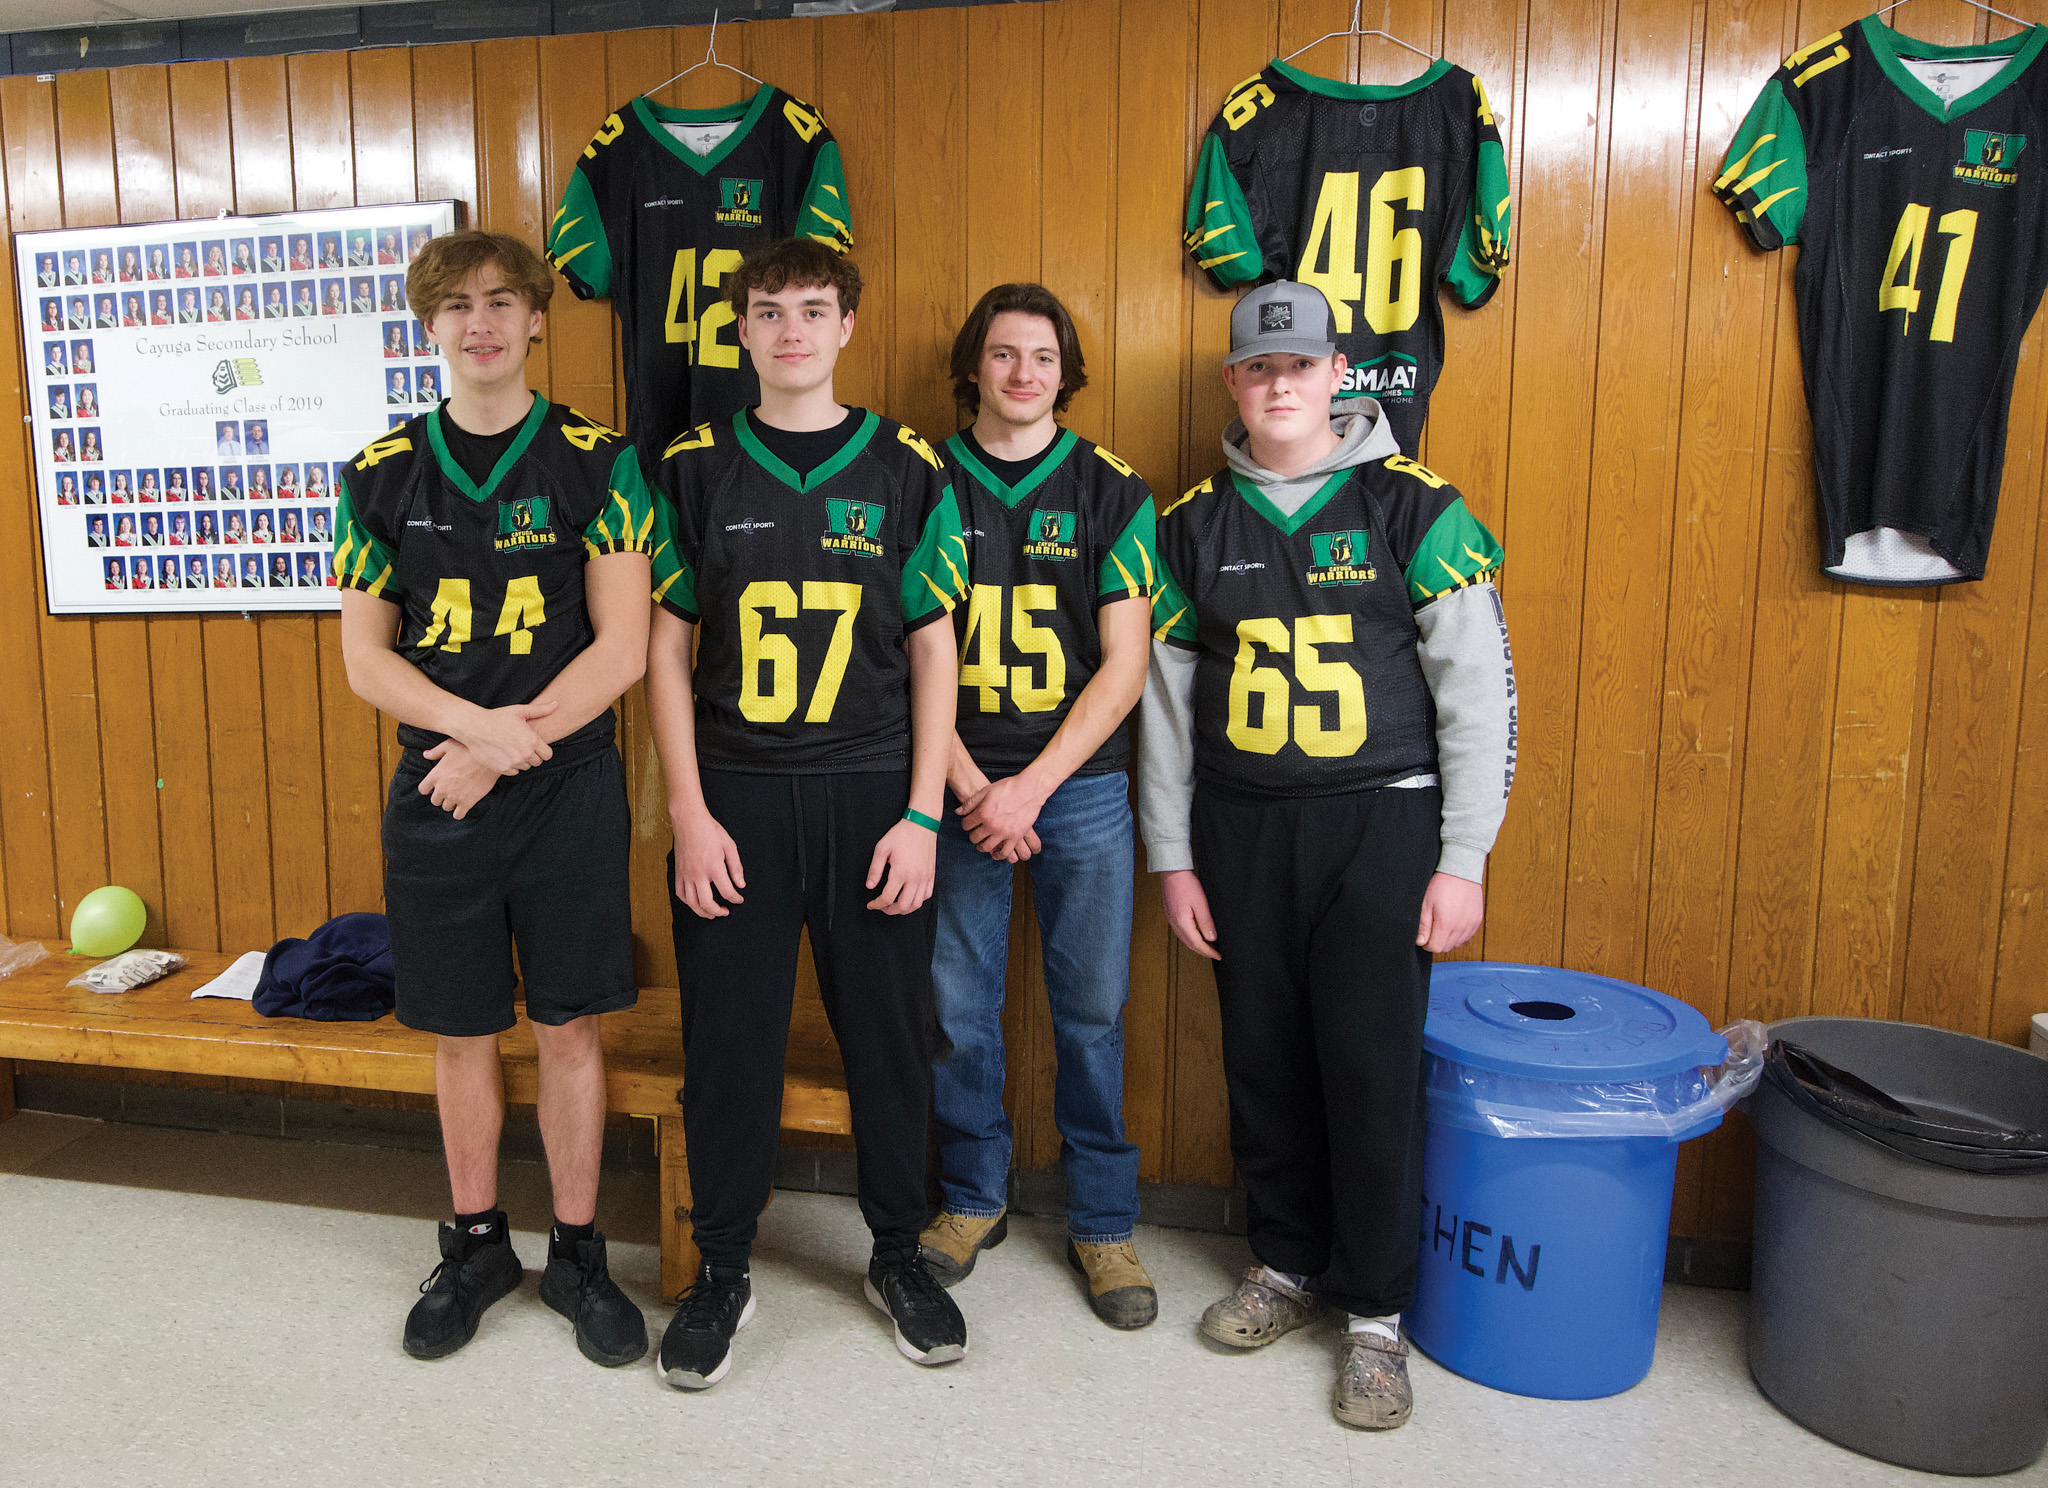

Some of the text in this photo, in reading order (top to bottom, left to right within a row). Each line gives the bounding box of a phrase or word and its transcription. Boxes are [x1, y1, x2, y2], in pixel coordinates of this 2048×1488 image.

[783, 97, 828, 143] 4
[1954, 166, 2018, 184] WARRIORS
[716, 212, 762, 224] WARRIORS
[1297, 166, 1426, 335] 46
[1879, 202, 1979, 343] 41
[664, 247, 745, 369] 42
[135, 337, 191, 357] Cayuga
[196, 328, 277, 352] Secondary
[282, 324, 339, 347] School
[159, 395, 323, 417] Graduating Class of 2019
[432, 522, 452, 531] ORTS
[511, 530, 533, 538] CAYUGA
[725, 521, 775, 532] CONTACT SPORTS
[494, 533, 556, 550] WARRIORS
[822, 538, 884, 556] WARRIORS
[843, 534, 866, 542] CAYUGA
[1023, 544, 1078, 558] WARRIORS
[1244, 562, 1265, 570] SPORTS
[1308, 569, 1376, 584] WARRIORS
[416, 575, 546, 655] 44
[738, 580, 863, 723] 67
[958, 583, 1066, 713] 45
[1226, 614, 1367, 758] 65
[1420, 1193, 1541, 1292] HEN
